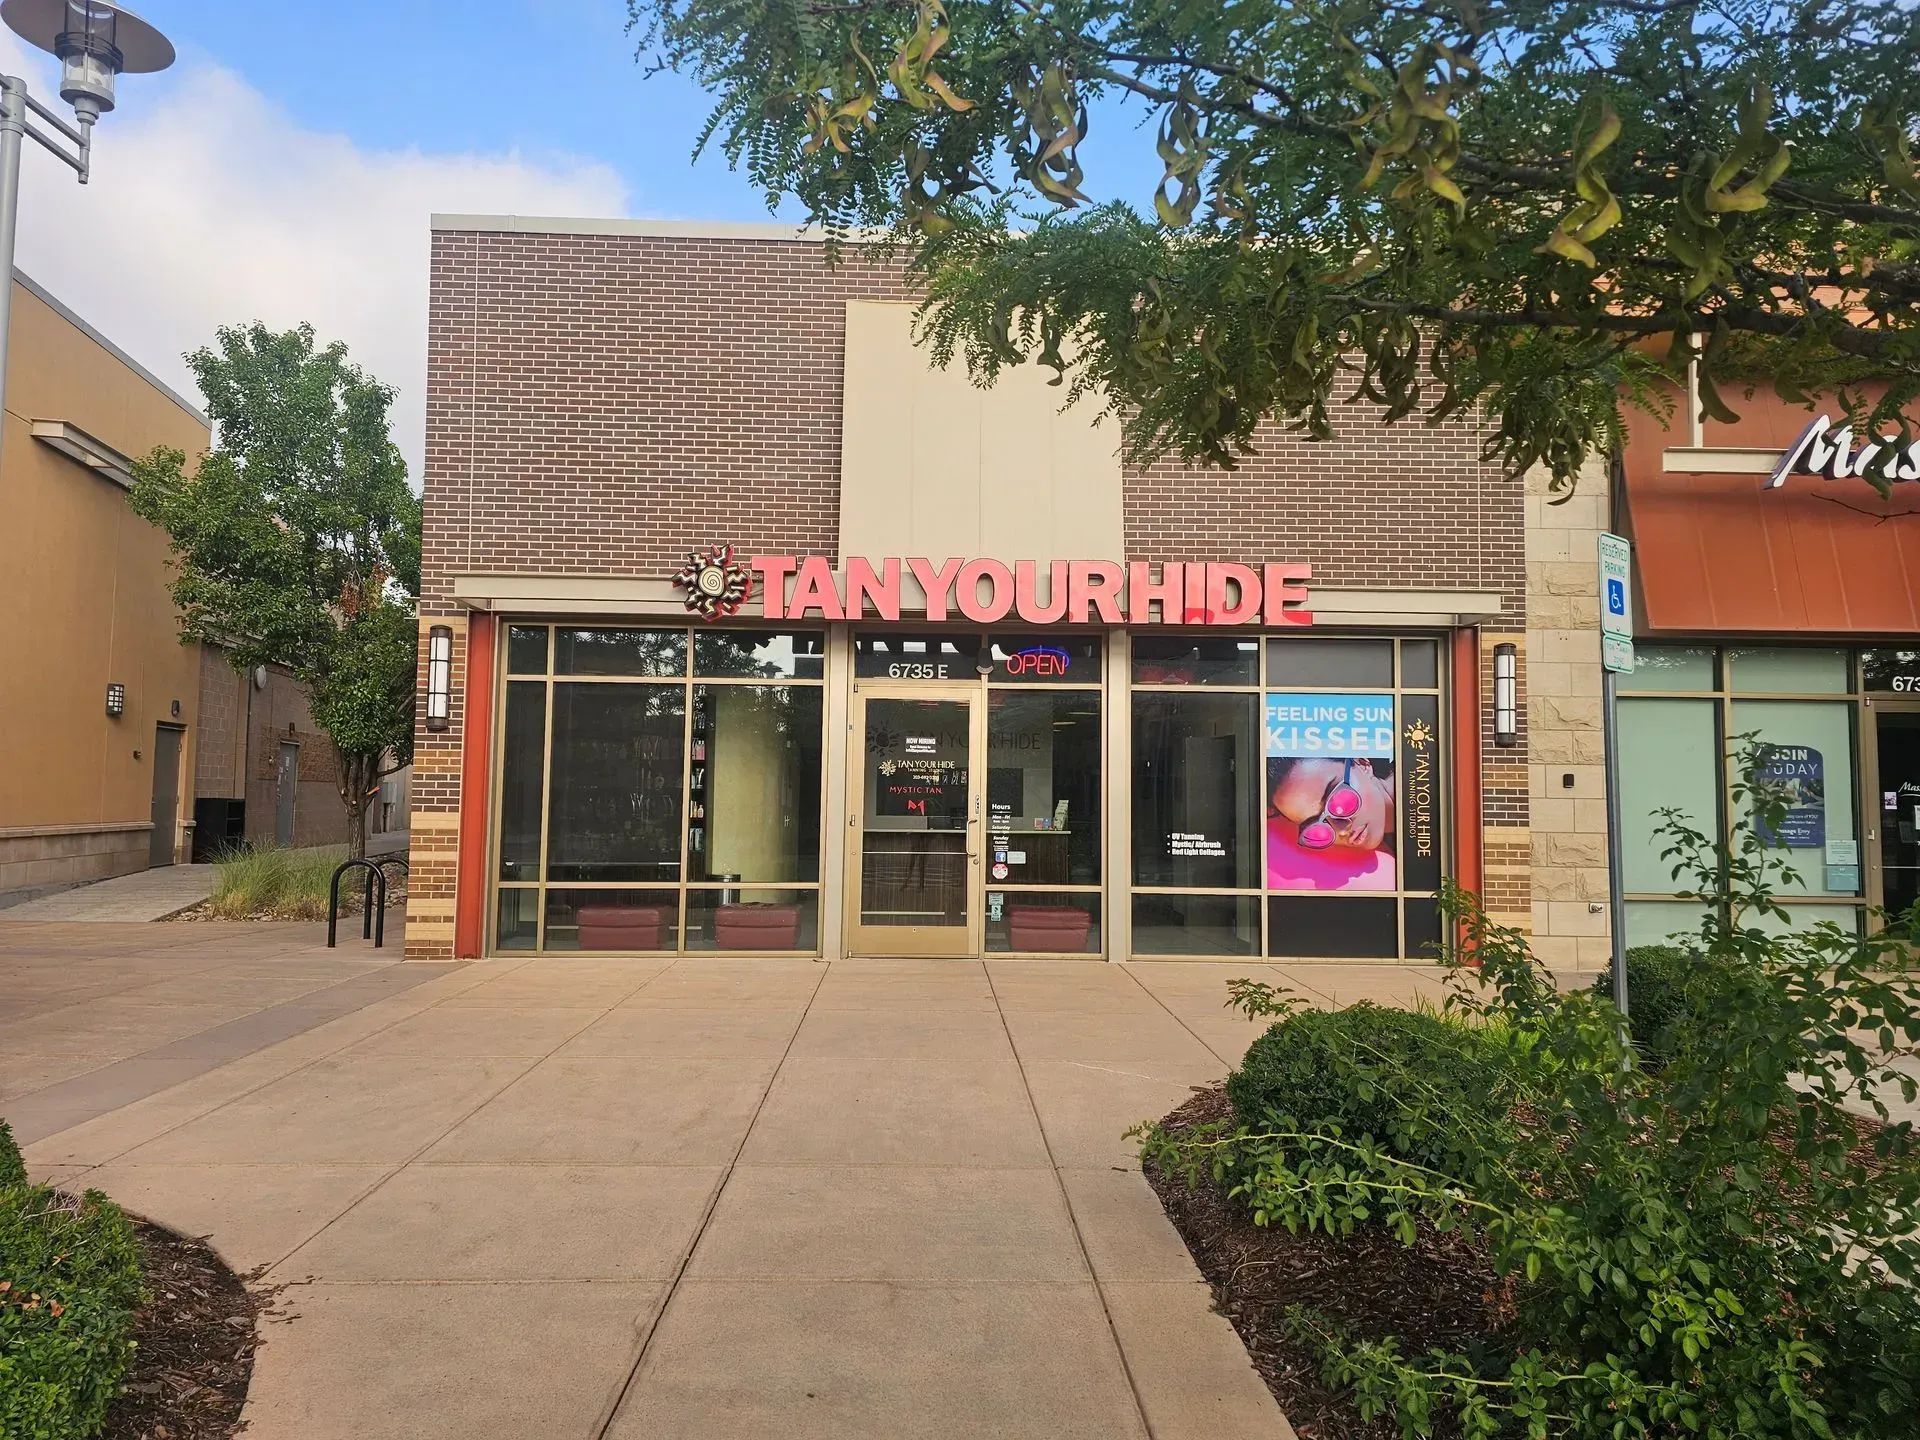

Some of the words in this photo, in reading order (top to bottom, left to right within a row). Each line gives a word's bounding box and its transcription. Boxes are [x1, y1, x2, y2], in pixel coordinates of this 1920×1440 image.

[1602, 542, 1628, 562] RESERVED
[1604, 560, 1626, 579] PARKING
[751, 555, 901, 621] TAN
[905, 557, 1125, 624] YOUR
[1129, 560, 1313, 627] HIDE
[888, 662, 934, 679] 6735
[937, 664, 949, 680] E
[1007, 653, 1066, 675] OPEN
[1265, 706, 1348, 722] FEELING
[1353, 707, 1393, 722] SUN
[1265, 726, 1394, 751] KISSED
[897, 760, 914, 768] TAN
[914, 760, 937, 768] YOUR
[937, 760, 955, 769] HIDE
[1771, 749, 1808, 761] JOIN
[1416, 752, 1430, 781] TAN
[1765, 763, 1818, 775] TODAY
[926, 786, 943, 794] TAN
[1408, 770, 1417, 805] TANNING
[1416, 783, 1430, 823] YOUR
[1409, 808, 1417, 839] STUDIOS
[1171, 832, 1181, 840] UV
[1181, 833, 1205, 841] Tanning
[1195, 840, 1221, 848] Airbrush
[1417, 825, 1431, 857] HIDE
[1184, 848, 1199, 856] Light
[1199, 848, 1226, 856] Collagen
